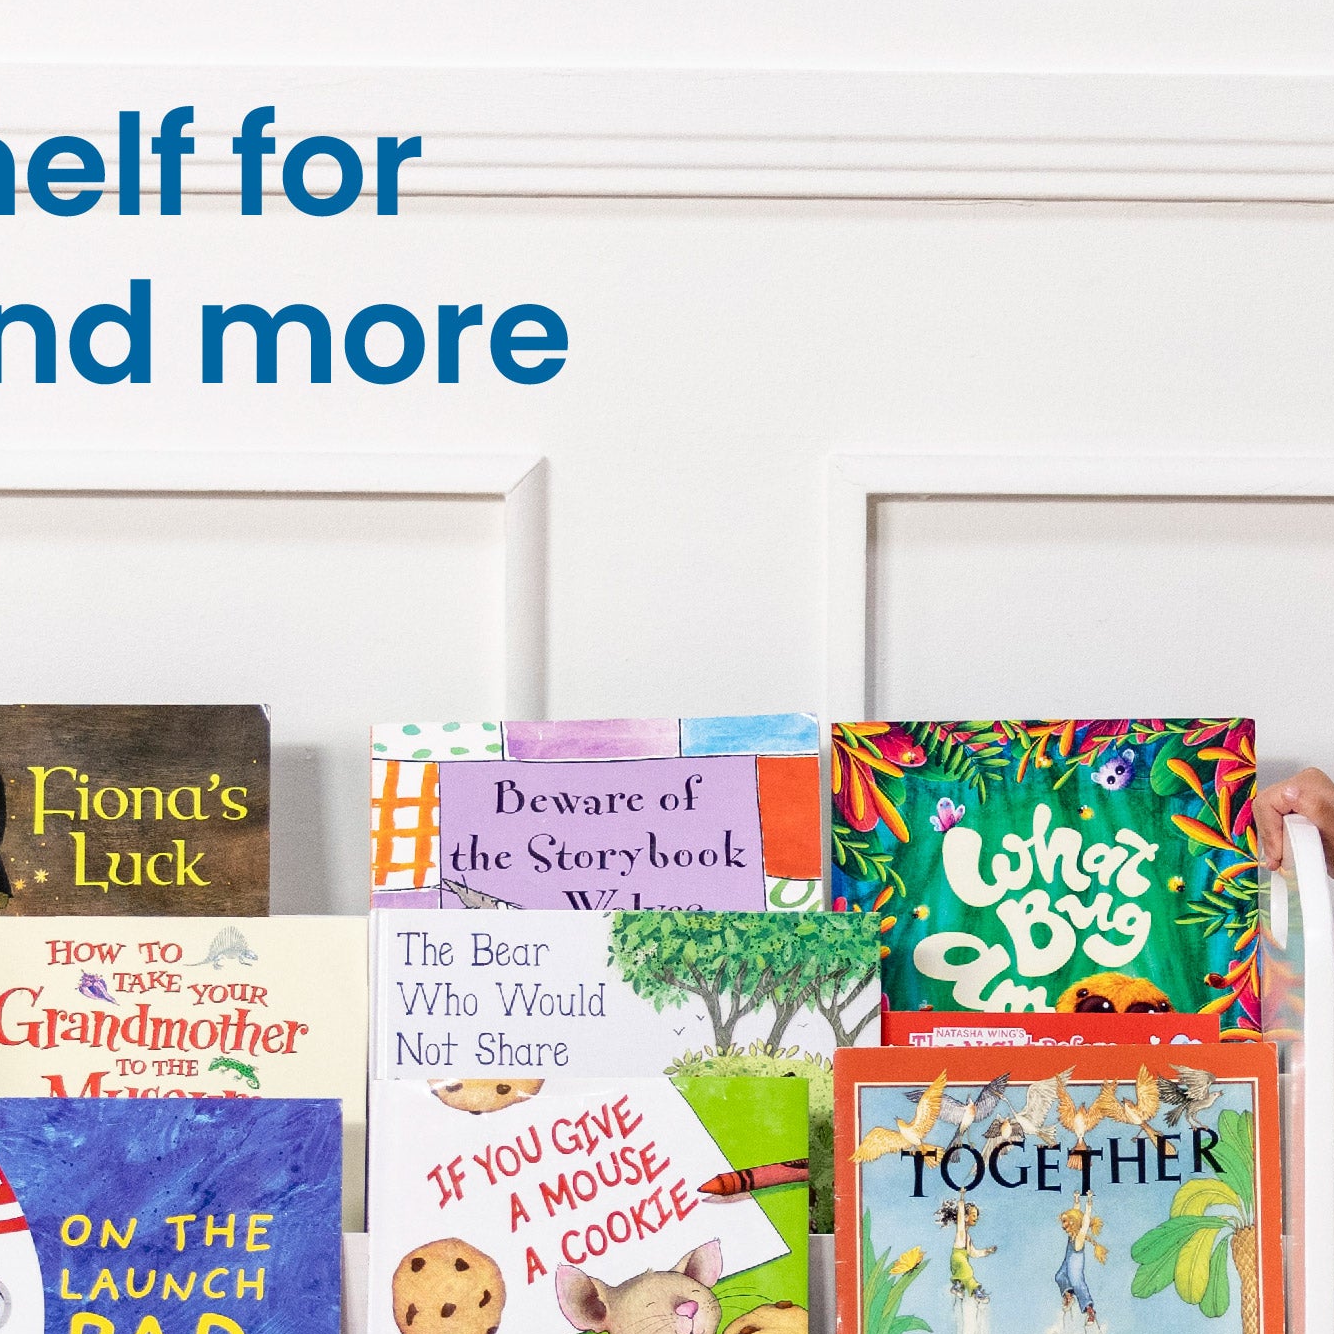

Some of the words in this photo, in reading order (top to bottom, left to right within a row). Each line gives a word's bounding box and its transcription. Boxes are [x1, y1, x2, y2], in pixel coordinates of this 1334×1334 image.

[27, 765, 249, 836] Fiona's
[494, 779, 644, 817] Beware
[660, 774, 703, 812] of
[68, 831, 212, 893] Luck
[450, 835, 512, 872] the
[527, 831, 748, 876] Storybook
[942, 803, 1159, 907] What
[138, 941, 183, 964] TO
[396, 932, 454, 967] The
[471, 932, 550, 967] Bear
[996, 889, 1152, 977] Bug
[113, 971, 182, 994] TAKE
[188, 984, 269, 1007] YOUR
[396, 982, 478, 1017] Who
[495, 983, 606, 1018] Would
[395, 1032, 458, 1067] Not
[475, 1032, 569, 1067] Share
[936, 1029, 983, 1038] NATASHA
[987, 1029, 1025, 1038] WING'S
[116, 1058, 147, 1077] TO
[152, 1058, 199, 1078] THE
[426, 1156, 467, 1210] IF
[473, 1126, 543, 1185] YOU
[551, 1095, 644, 1158] GIVE
[900, 1127, 1227, 1198] TOGETHER
[510, 1192, 529, 1233] A
[539, 1141, 671, 1218] MOUSE
[60, 1214, 137, 1249] ON
[166, 1214, 274, 1253] THE
[525, 1246, 548, 1285] A
[562, 1178, 700, 1266] COOKIE
[60, 1267, 265, 1301] LAUNCH
